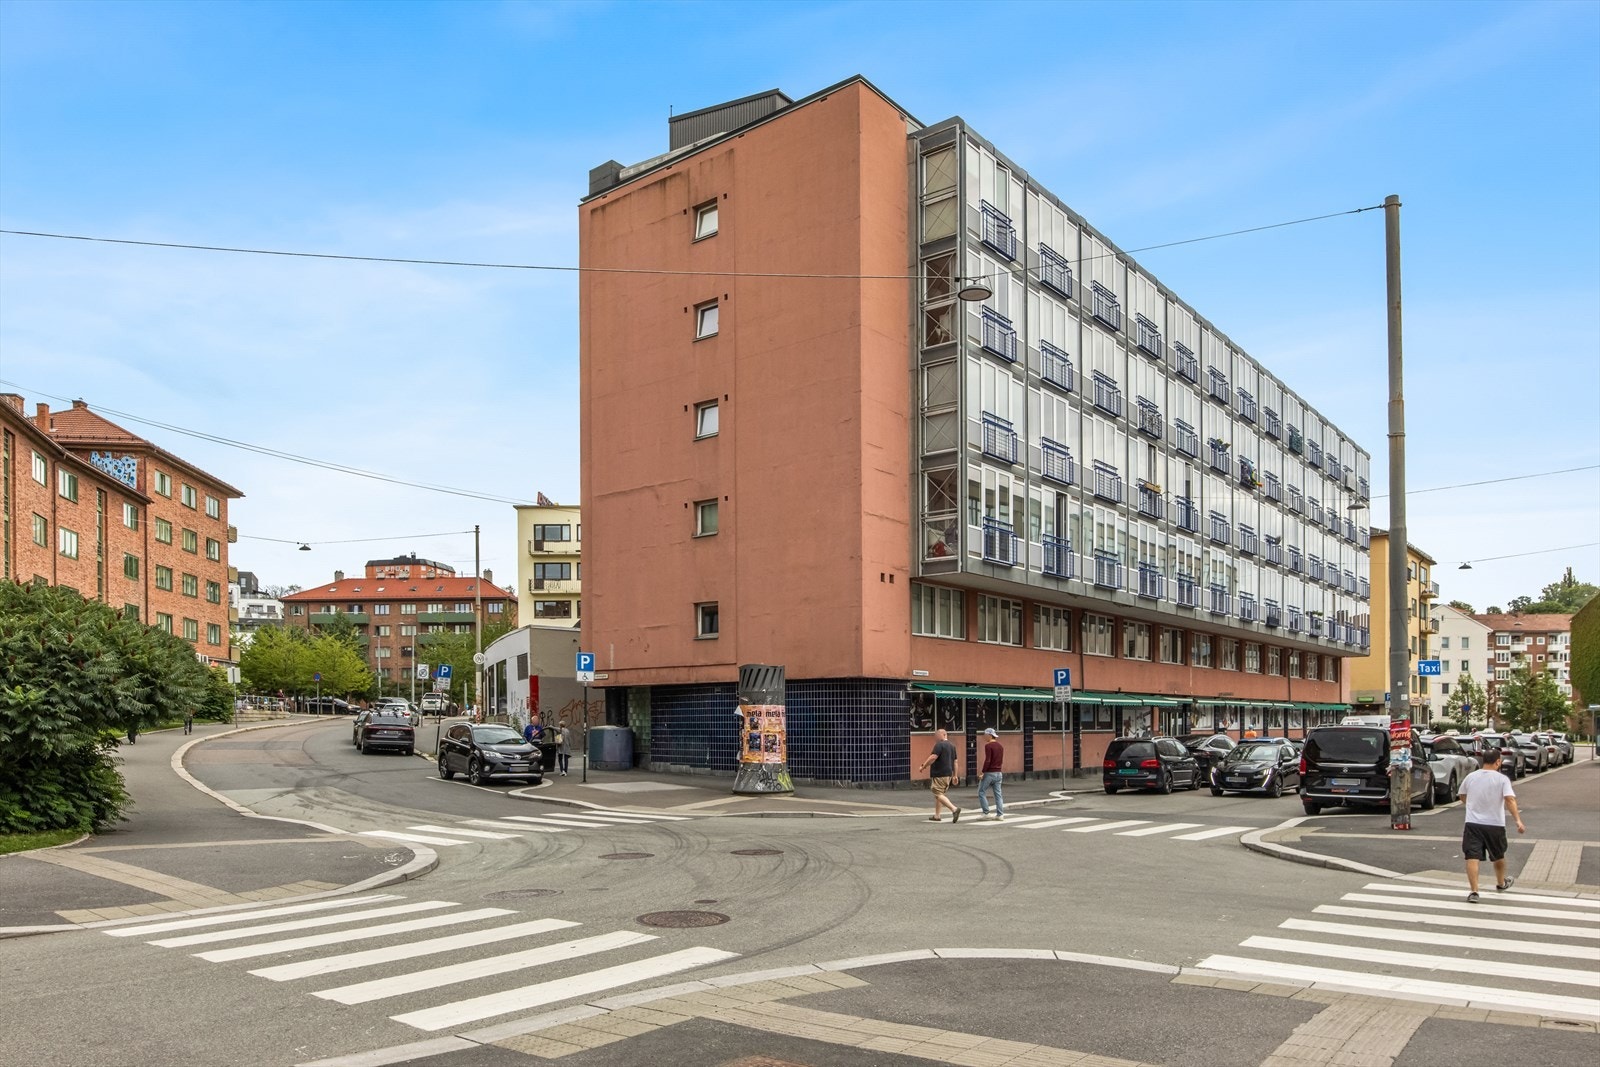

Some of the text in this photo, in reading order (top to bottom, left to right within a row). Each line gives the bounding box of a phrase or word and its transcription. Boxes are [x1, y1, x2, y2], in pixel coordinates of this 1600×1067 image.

[580, 655, 591, 670] P
[1419, 663, 1440, 673] Taxi
[441, 666, 449, 676] P
[1057, 670, 1067, 685] P
